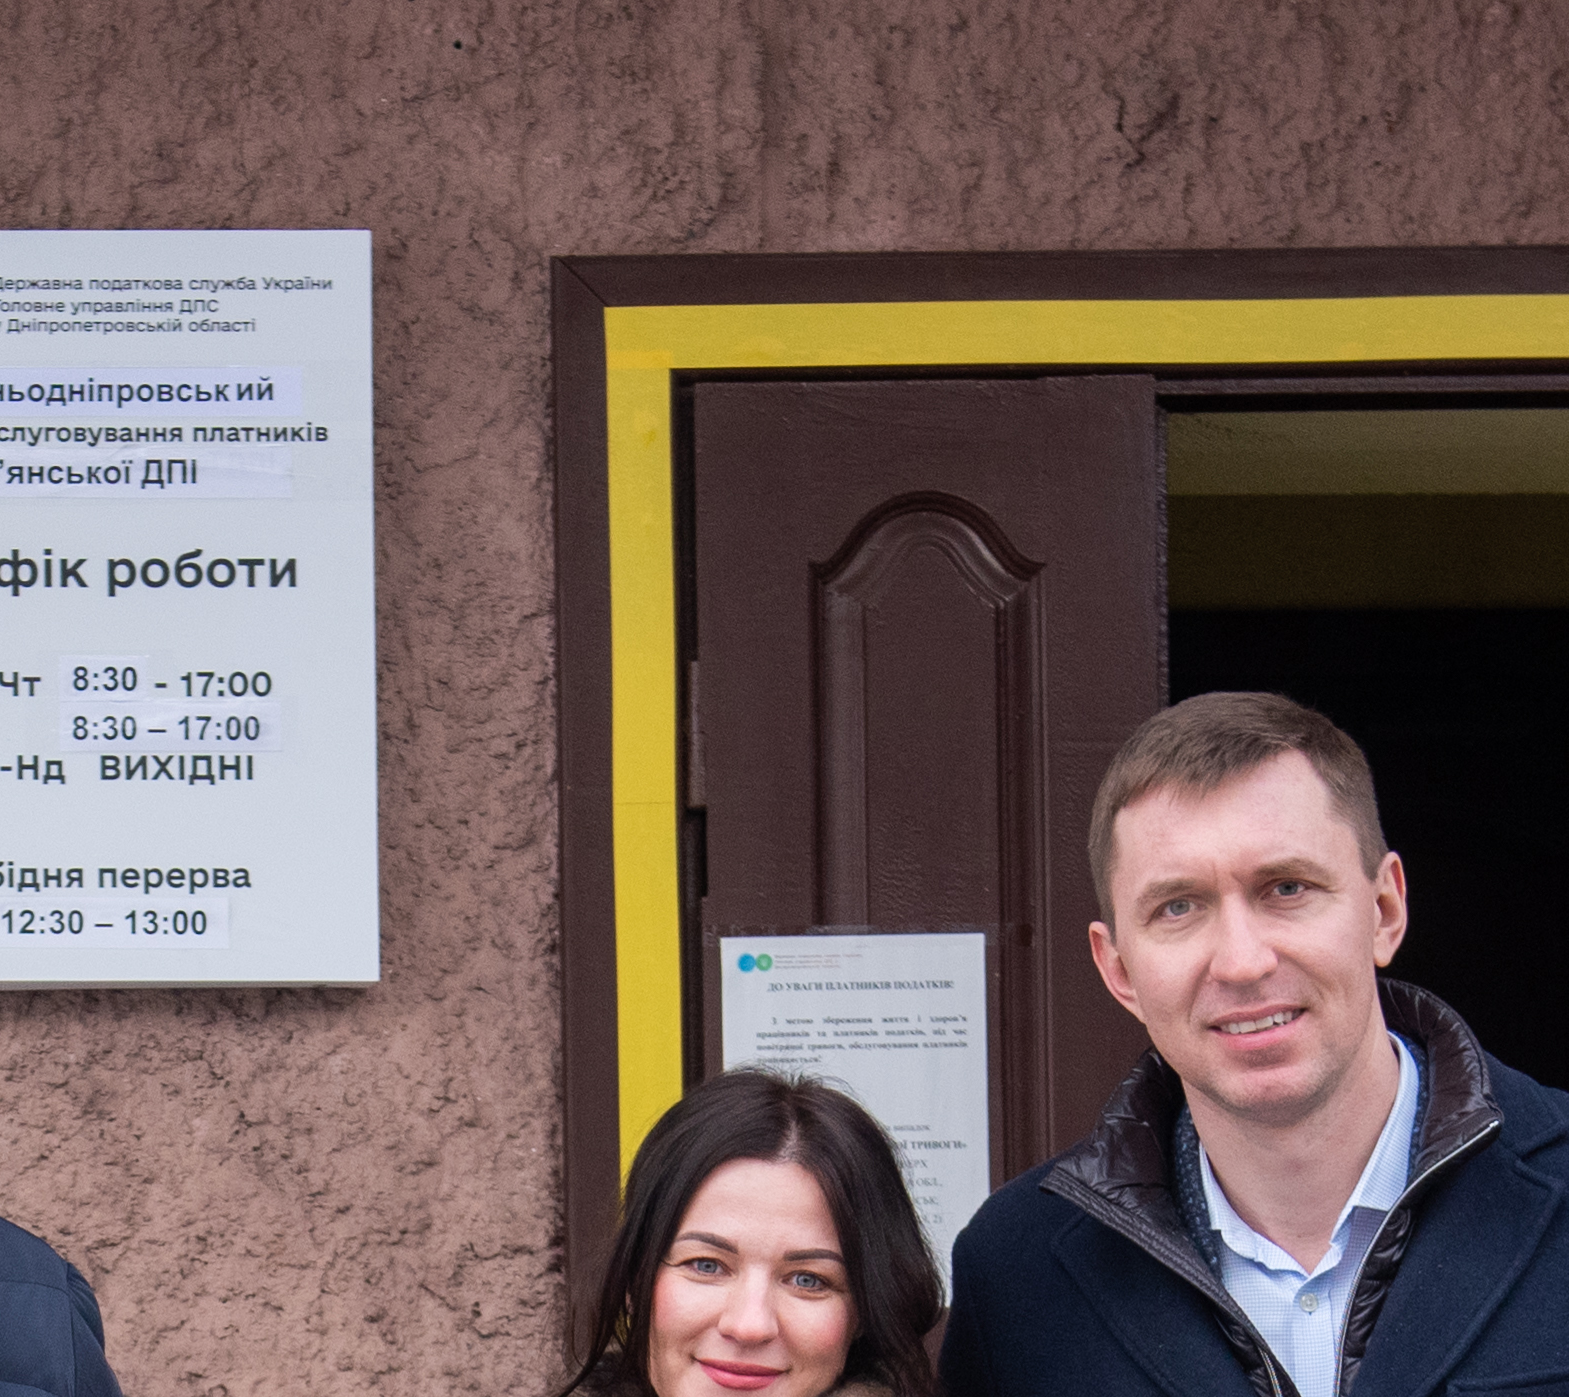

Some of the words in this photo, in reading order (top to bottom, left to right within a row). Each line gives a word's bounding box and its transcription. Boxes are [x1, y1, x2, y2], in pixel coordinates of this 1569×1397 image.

[89, 279, 183, 291] податкова
[189, 277, 256, 293] служба
[262, 276, 332, 292] України
[71, 302, 173, 315] управління
[179, 299, 218, 314] ДПС
[7, 319, 182, 334] Дніпропетровській
[189, 319, 255, 332] області
[193, 422, 328, 442] платників
[141, 459, 196, 489] ДПІ
[108, 549, 296, 597] роботи
[73, 666, 137, 691] 8:30
[181, 672, 272, 697] 17:00
[73, 716, 137, 740] 8:30
[179, 716, 260, 741] 17:00
[101, 755, 253, 785] ВИХІДНІ
[99, 868, 251, 894] перерва
[2, 910, 83, 934] 12:30
[125, 910, 207, 935] 13:00
